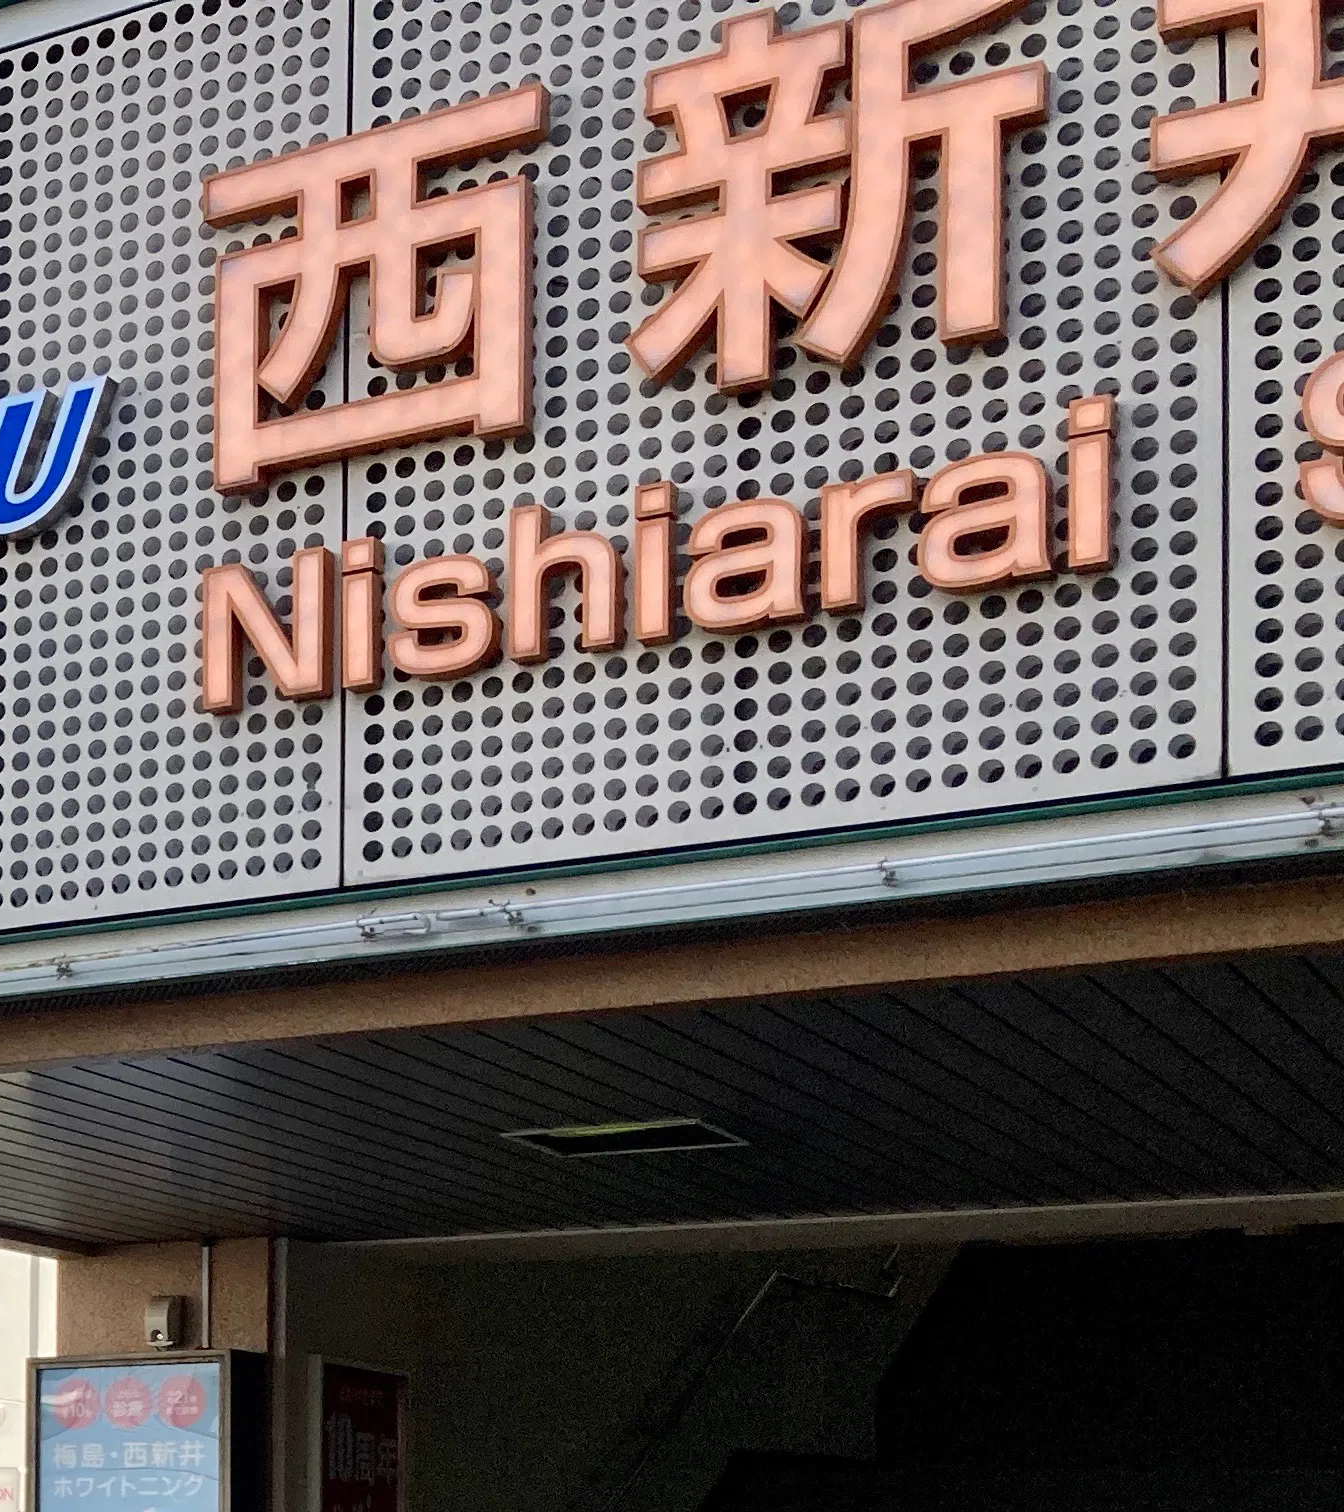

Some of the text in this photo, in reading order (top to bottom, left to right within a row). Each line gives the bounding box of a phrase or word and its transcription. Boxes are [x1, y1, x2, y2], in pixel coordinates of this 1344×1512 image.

[200, 395, 1118, 715] Nishiarai
[53, 1440, 206, 1470] 梅島・西新井
[53, 1474, 205, 1498] ホワイトニング
